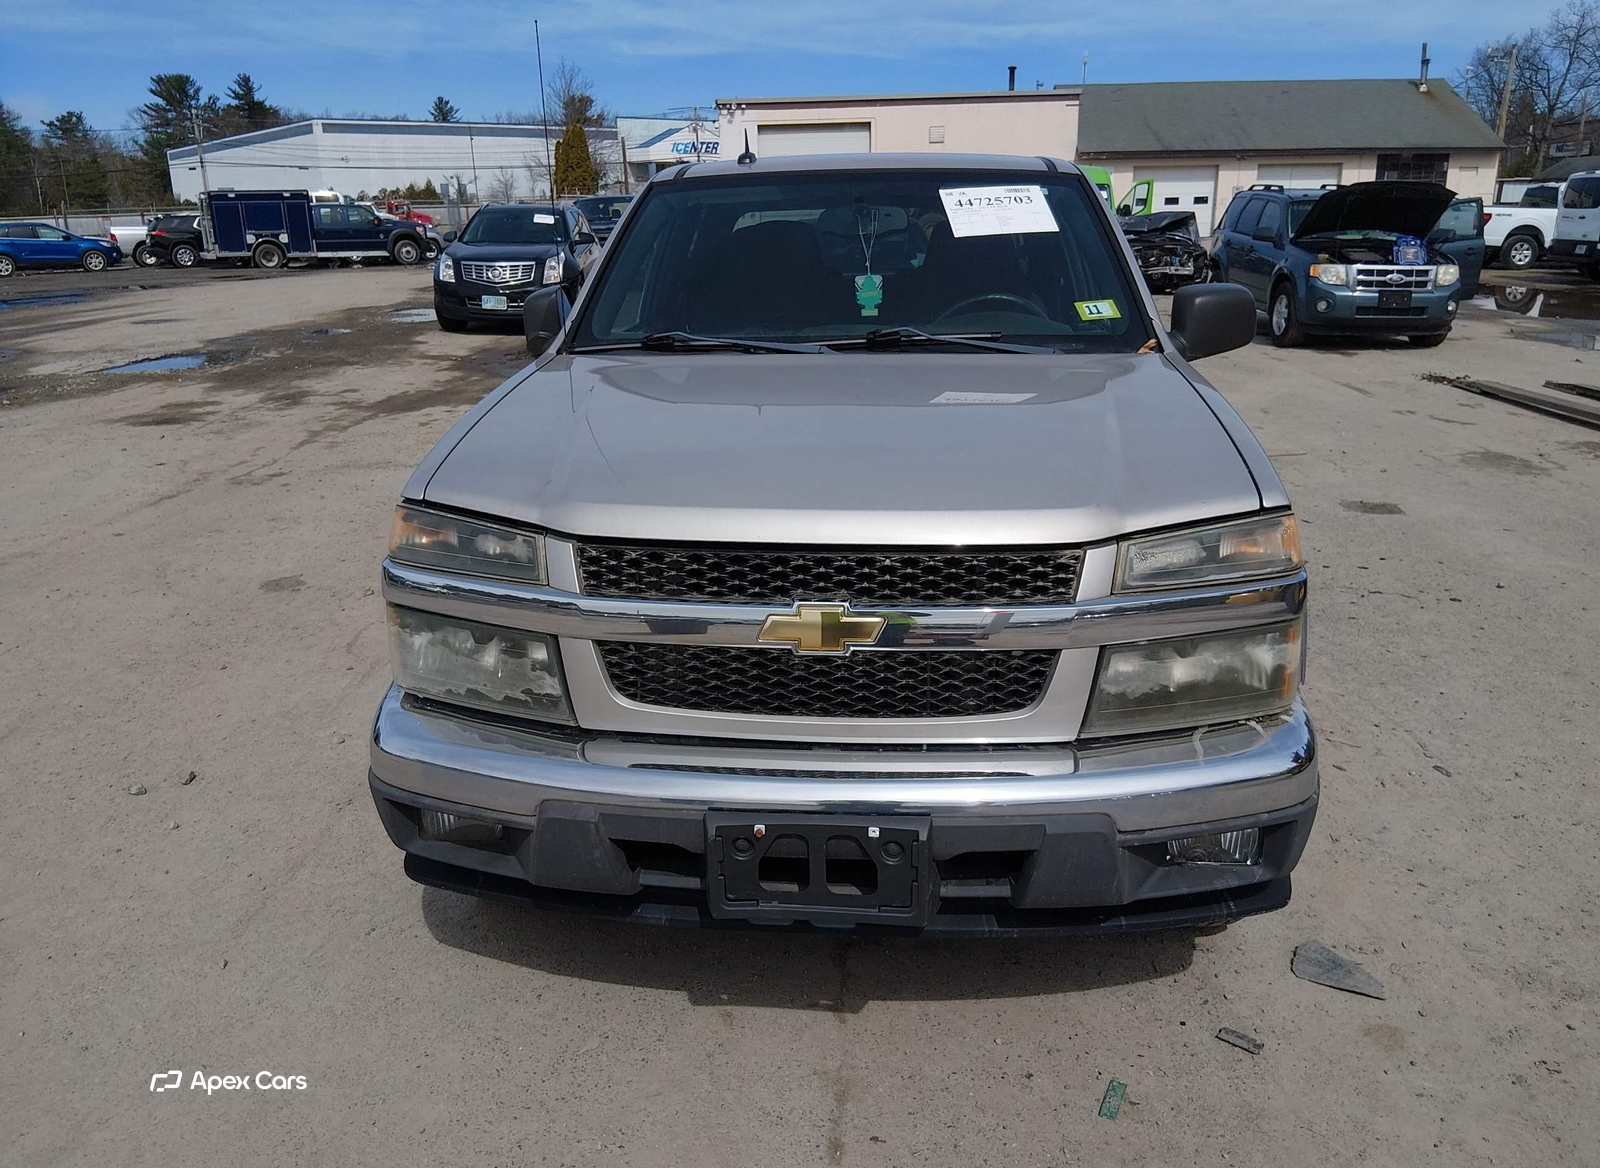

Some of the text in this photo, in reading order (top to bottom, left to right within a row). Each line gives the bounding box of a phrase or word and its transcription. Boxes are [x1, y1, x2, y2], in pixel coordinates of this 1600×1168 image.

[671, 141, 720, 154] ICENTER
[954, 195, 1033, 208] 44725703
[1085, 304, 1104, 316] 11
